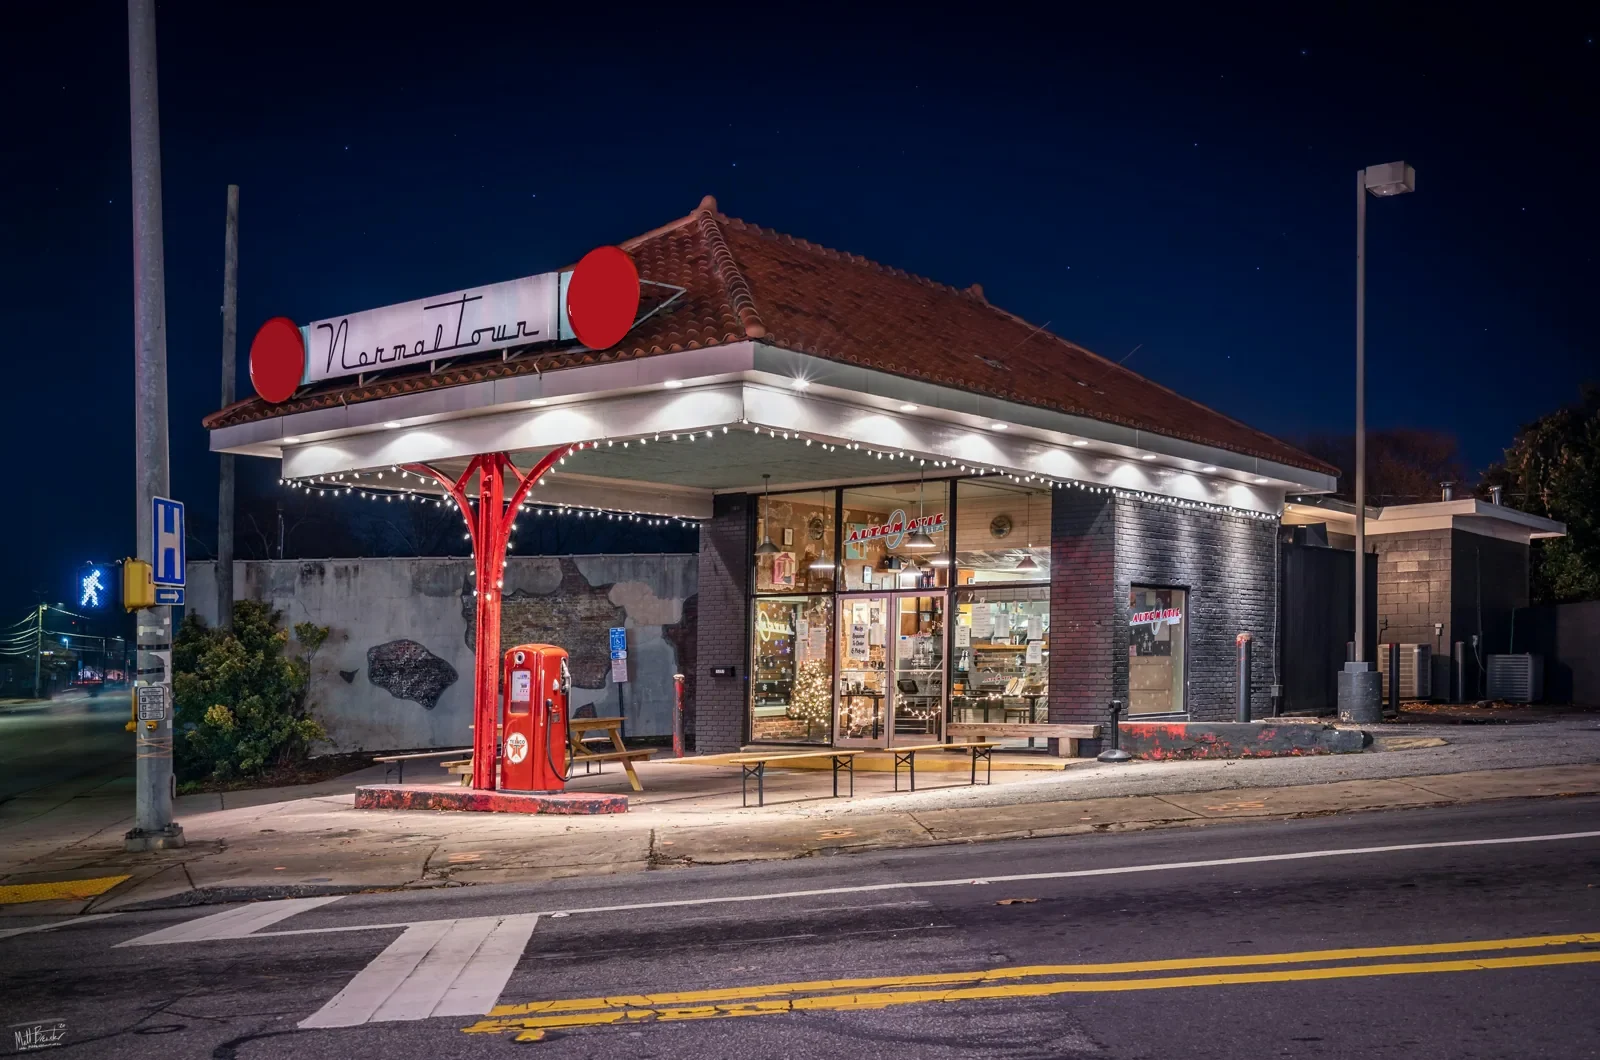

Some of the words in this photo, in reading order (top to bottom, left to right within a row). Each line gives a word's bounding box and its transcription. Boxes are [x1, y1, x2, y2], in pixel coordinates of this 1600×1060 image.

[157, 503, 181, 579] H
[848, 512, 945, 541] AUTOMATIC
[1132, 607, 1180, 622] AUTOMATIC
